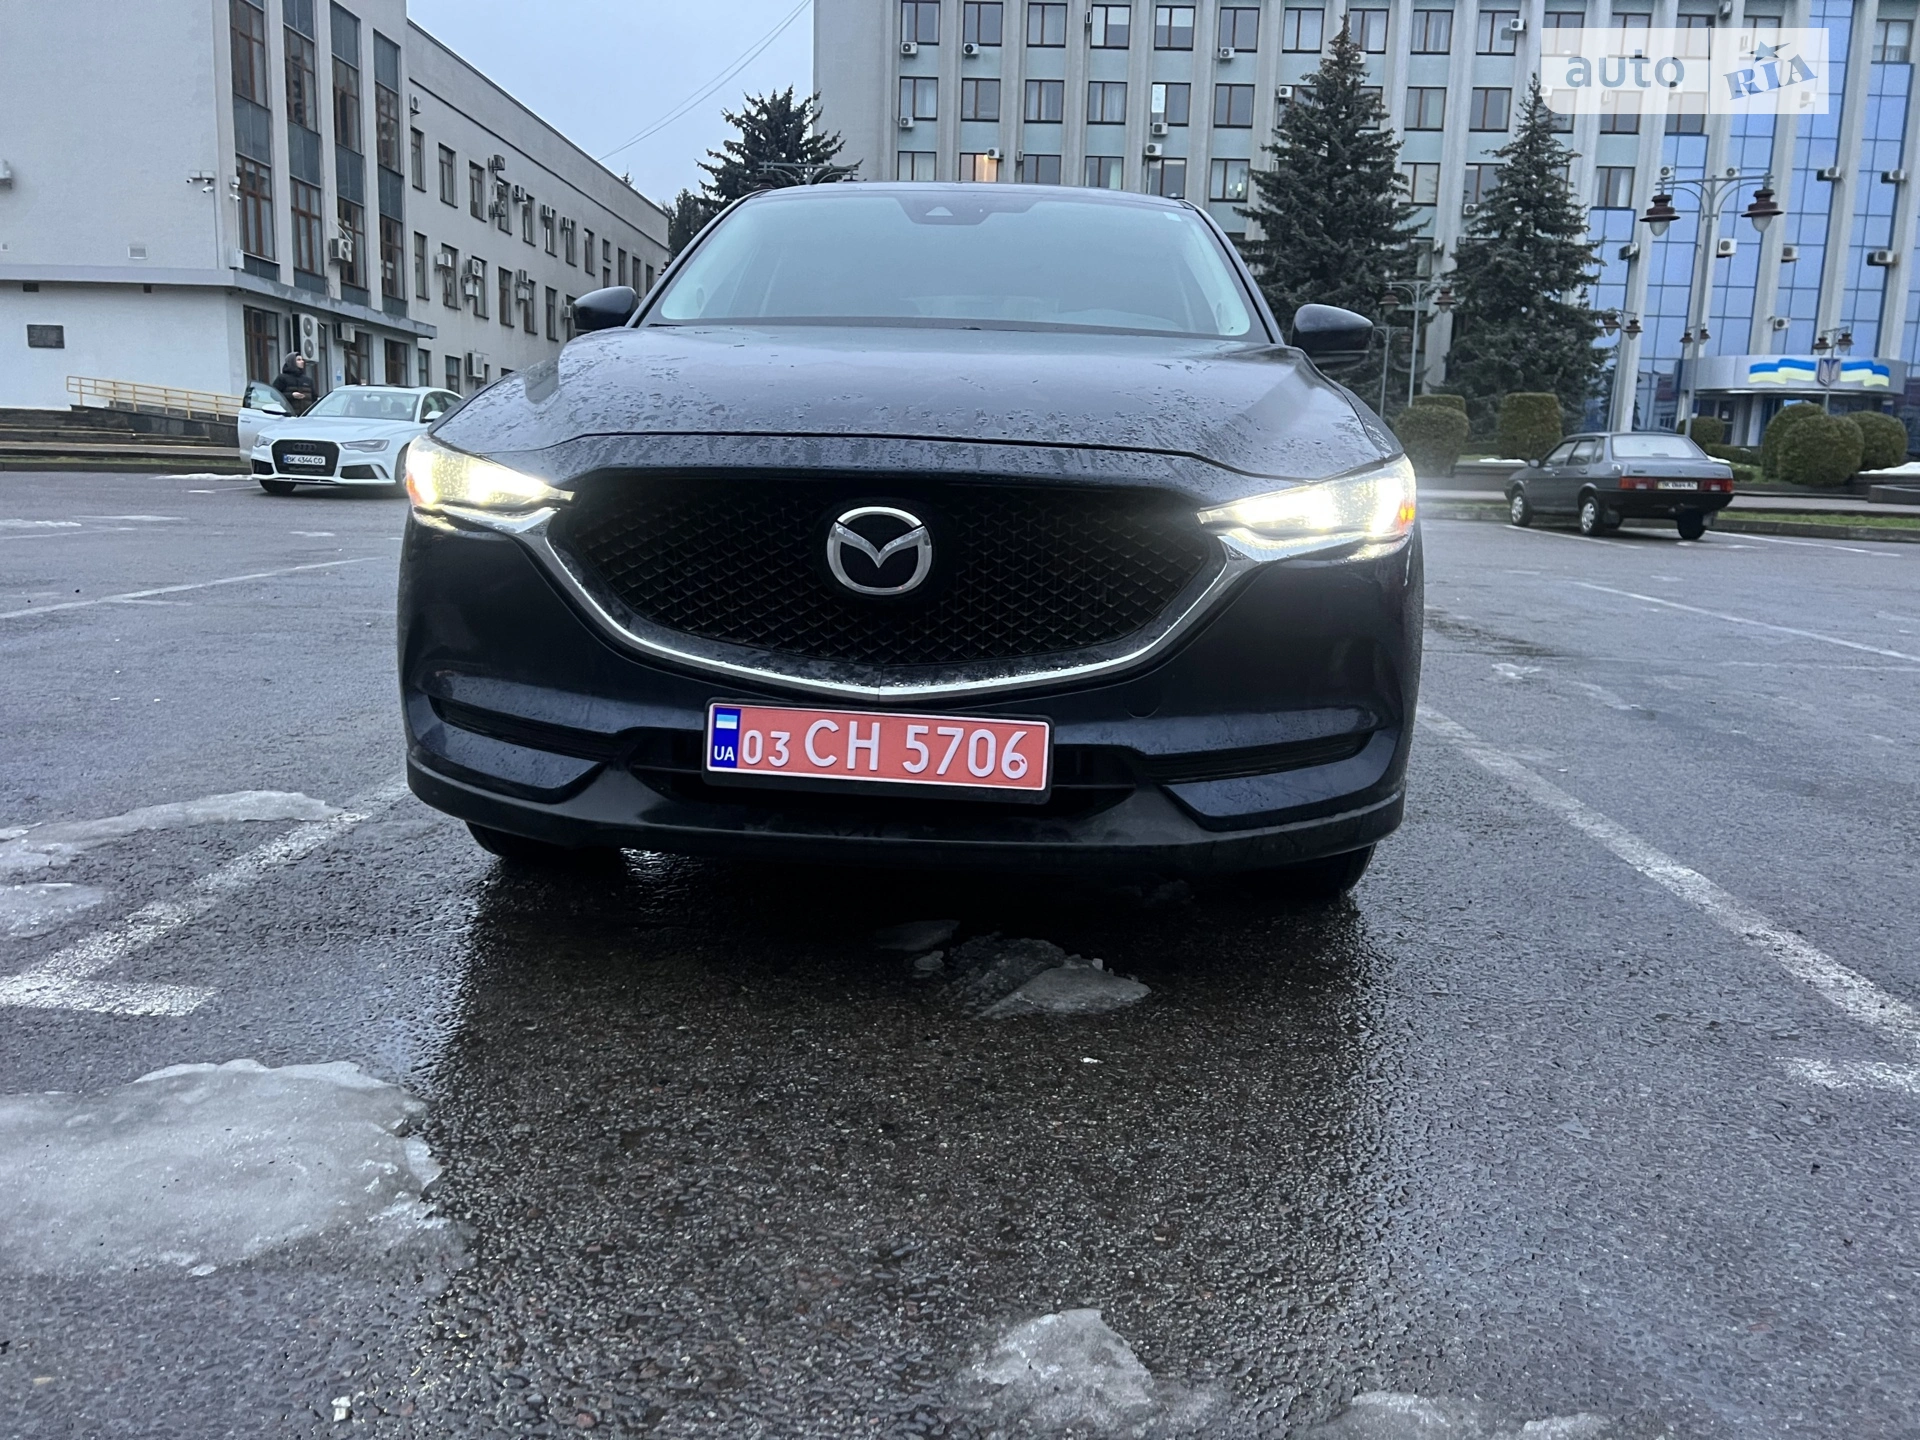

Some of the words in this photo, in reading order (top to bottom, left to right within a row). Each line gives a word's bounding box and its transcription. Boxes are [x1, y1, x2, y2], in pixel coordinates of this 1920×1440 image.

[714, 745, 735, 762] UA
[742, 729, 790, 767] 03
[804, 719, 881, 771] CH
[902, 724, 1029, 780] 5706
